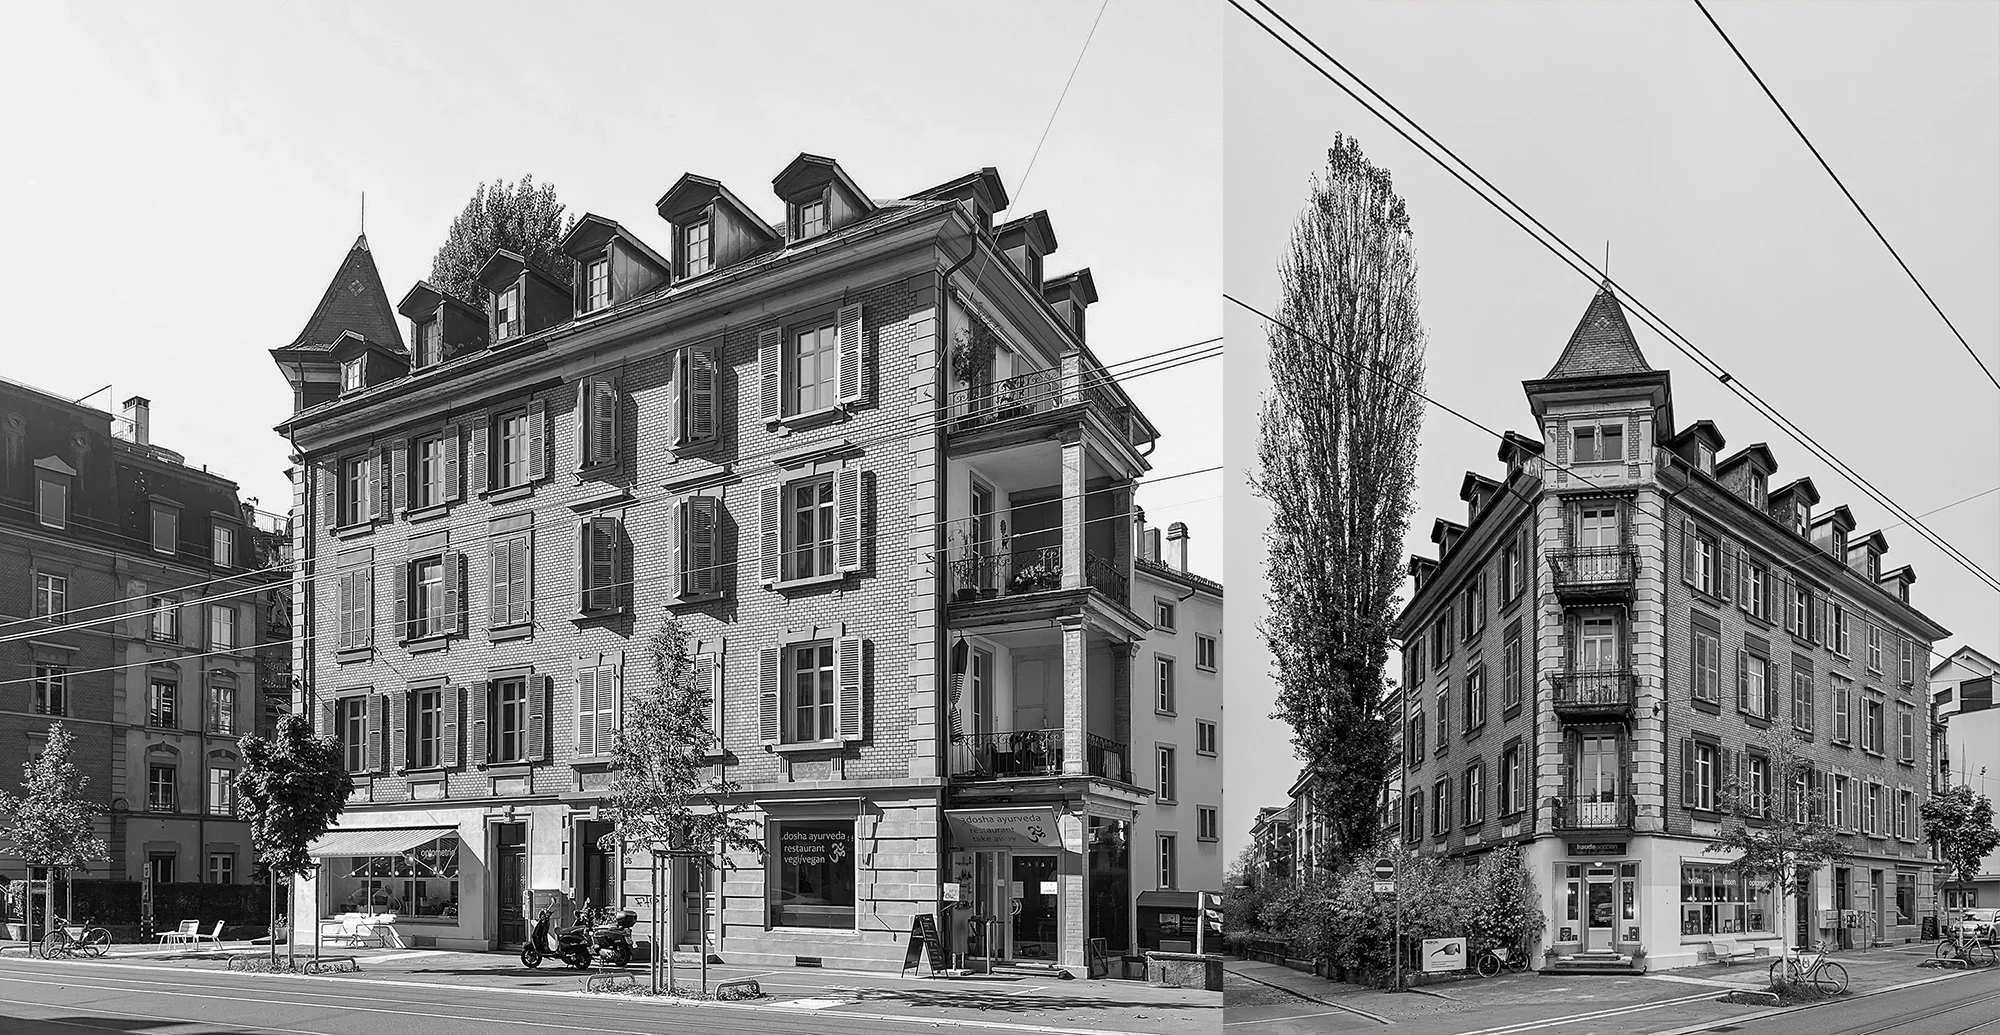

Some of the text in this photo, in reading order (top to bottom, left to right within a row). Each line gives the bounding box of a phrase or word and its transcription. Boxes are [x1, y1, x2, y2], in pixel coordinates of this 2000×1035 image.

[996, 814, 1042, 824] ayurveda
[808, 831, 846, 842] ayurveda
[973, 835, 991, 843] take
[784, 845, 825, 853] restaurant
[783, 854, 825, 866] vegi/vegan
